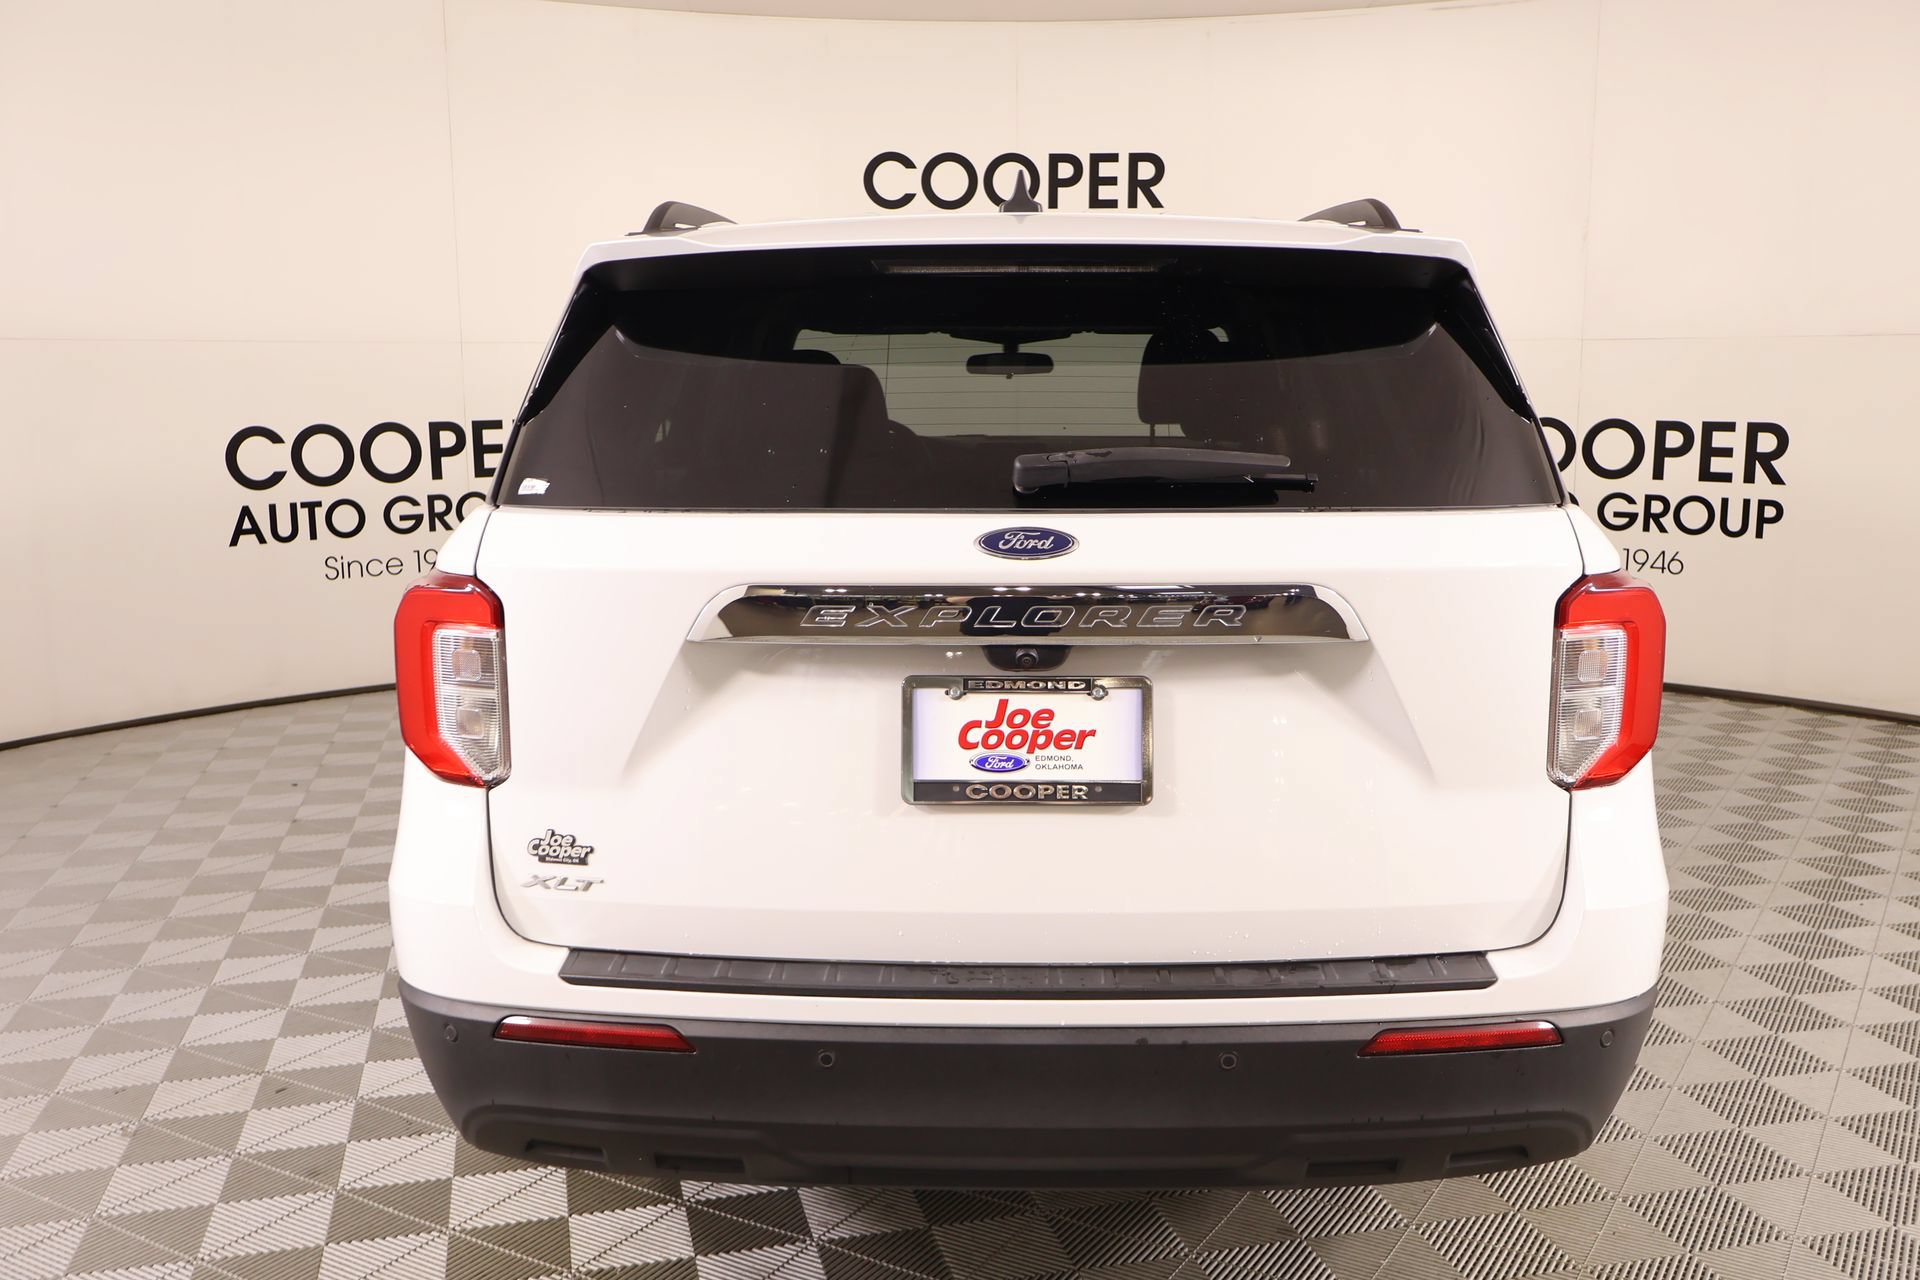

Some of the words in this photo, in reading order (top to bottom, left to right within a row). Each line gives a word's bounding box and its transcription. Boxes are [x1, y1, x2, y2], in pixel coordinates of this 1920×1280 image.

[863, 151, 1166, 210] COOPER
[225, 419, 516, 490] COOPE
[229, 498, 367, 547] AUTO
[383, 491, 488, 534] GRO
[1597, 491, 1785, 539] GROUP
[998, 530, 1055, 551] Ford
[324, 555, 404, 580] Since
[413, 548, 438, 573] 19
[1622, 548, 1684, 575] 1946
[799, 604, 1248, 628] EXPLORER
[967, 680, 1087, 690] EDMOND
[985, 698, 1055, 729] Joe
[958, 719, 1097, 754] Cooper
[984, 755, 1015, 769] Ford
[965, 784, 1089, 800] COOPER
[528, 838, 593, 858] Cooper
[540, 829, 575, 846] Joe
[520, 874, 605, 892] XLT
